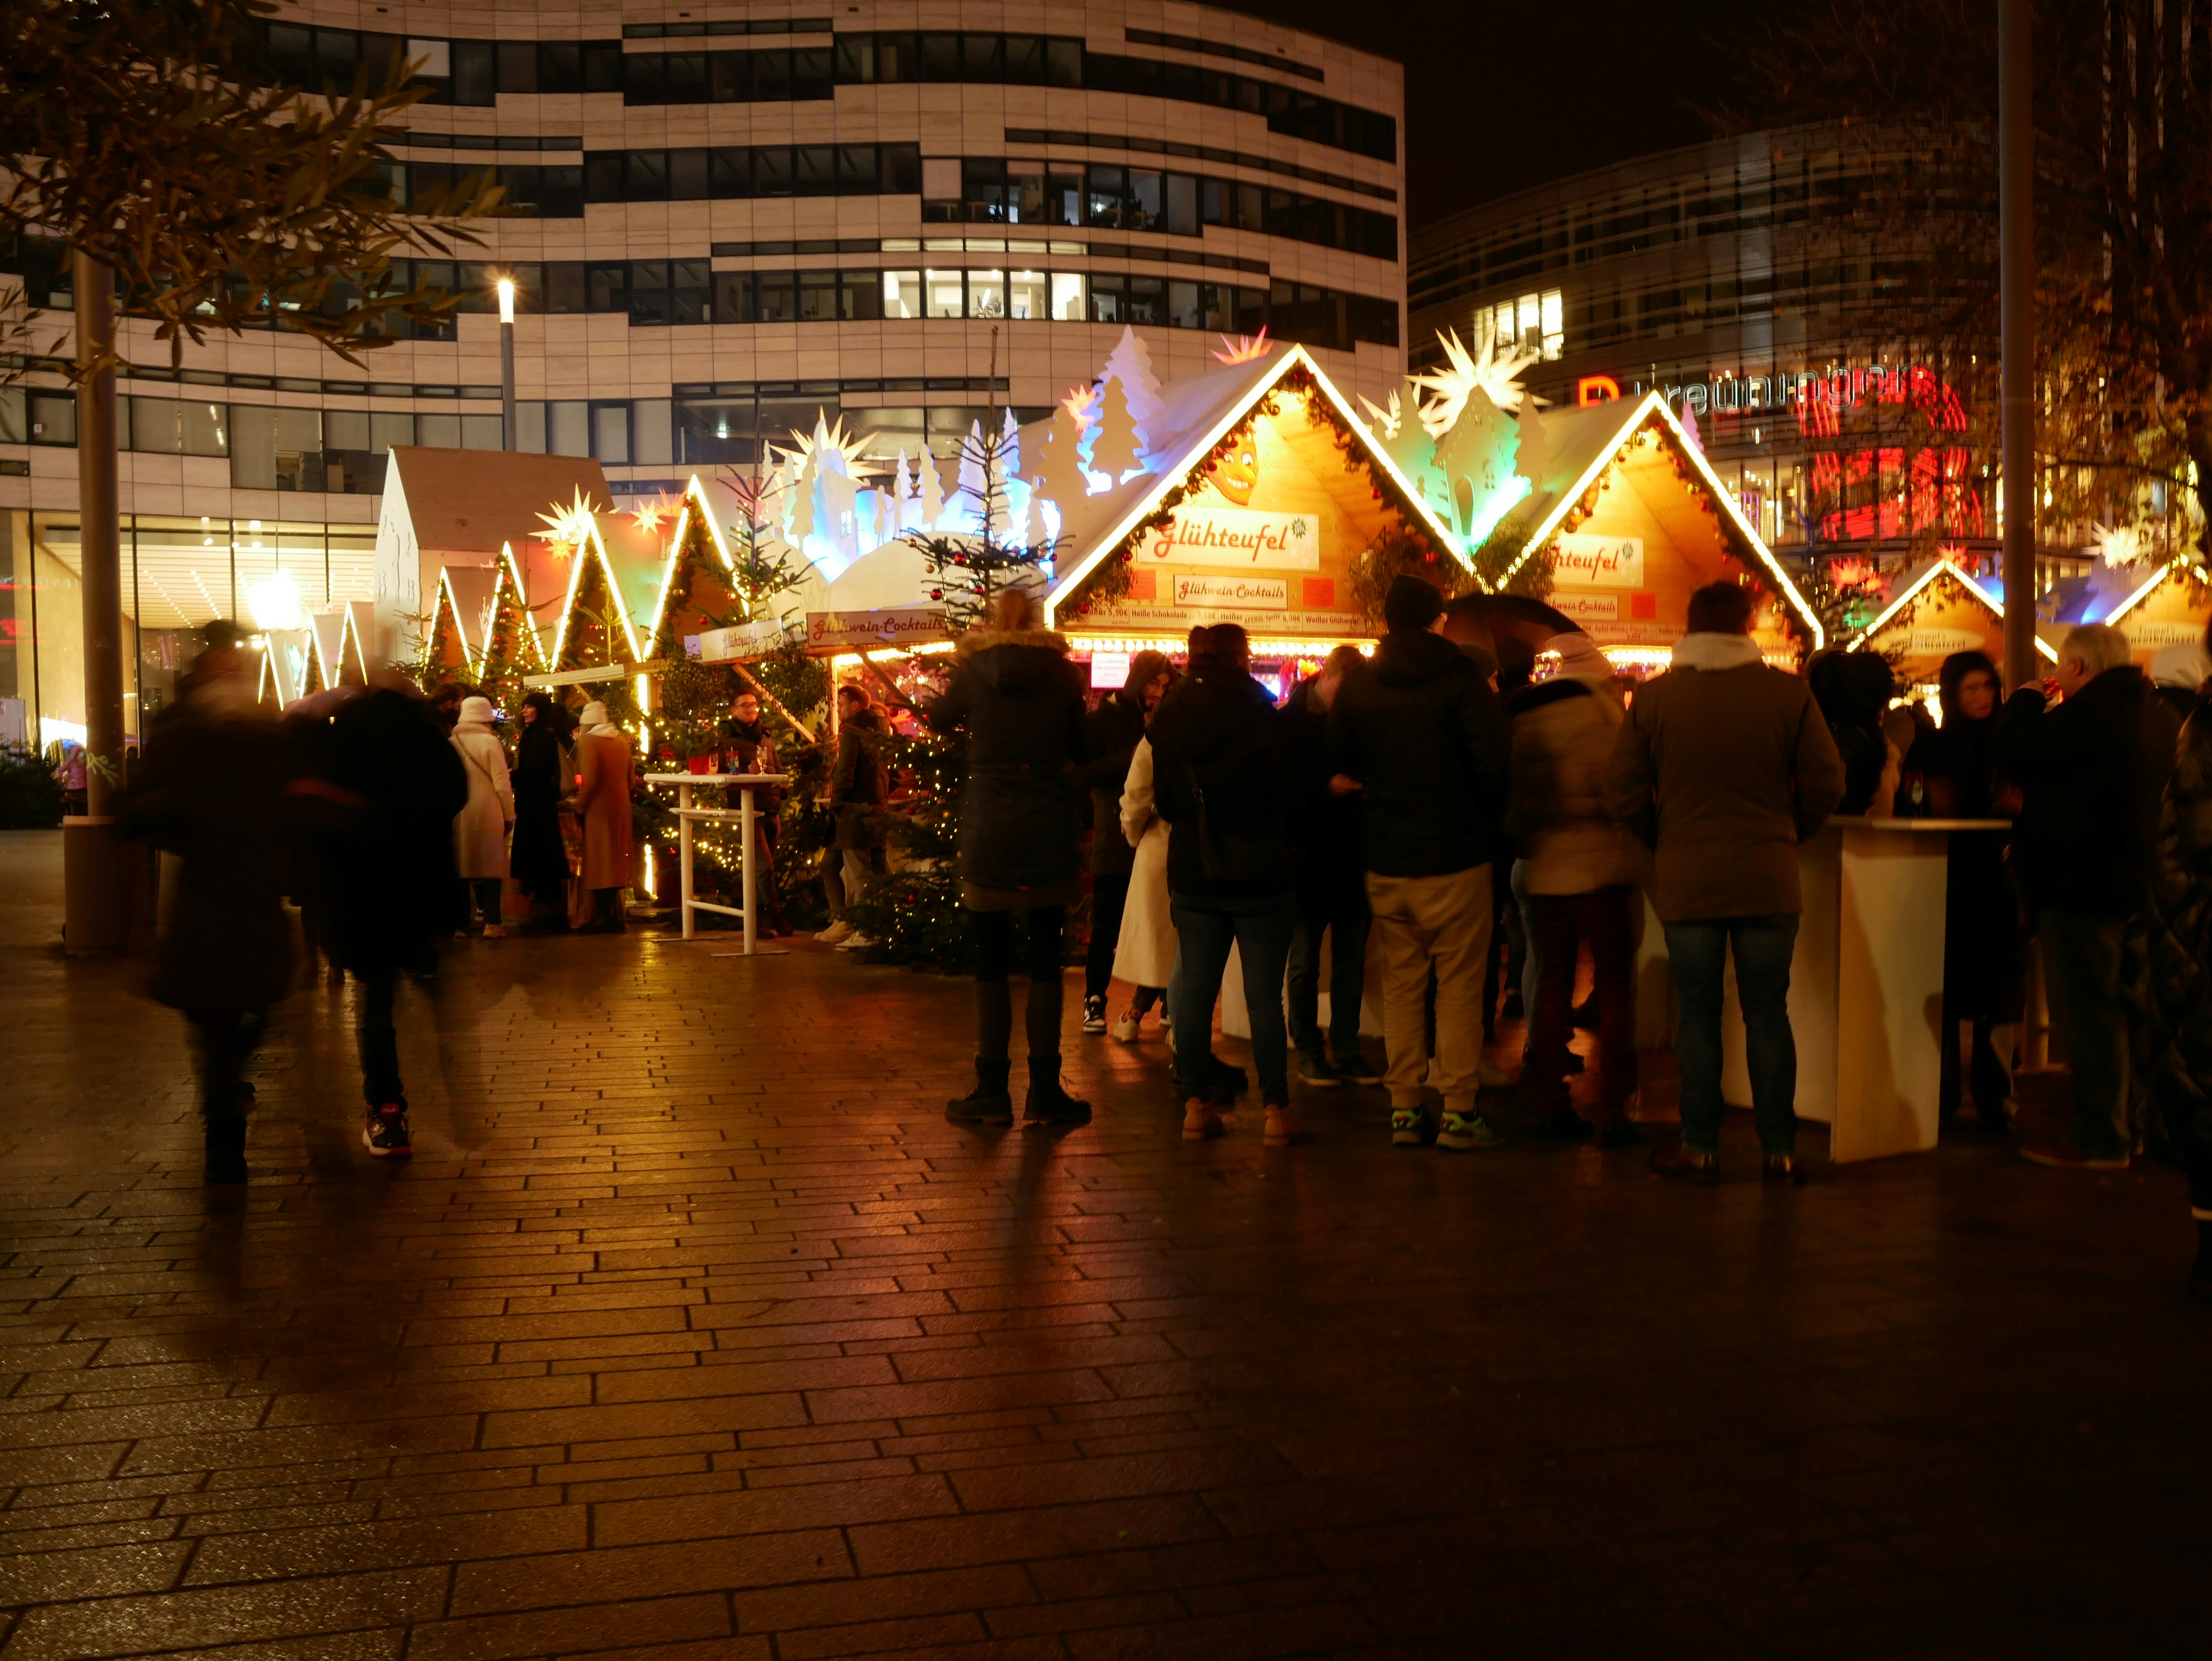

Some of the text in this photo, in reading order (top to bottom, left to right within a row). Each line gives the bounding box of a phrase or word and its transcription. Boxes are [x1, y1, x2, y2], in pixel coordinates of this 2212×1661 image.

[1634, 363, 1912, 416] reuninger
[1154, 518, 1288, 561] Glühteufel
[1132, 609, 1150, 618] Heiße
[1152, 609, 1187, 619] Schokolade
[1220, 612, 1243, 620] Heißer
[1306, 615, 1328, 624] Weißer
[723, 629, 757, 656] Glühteufel
